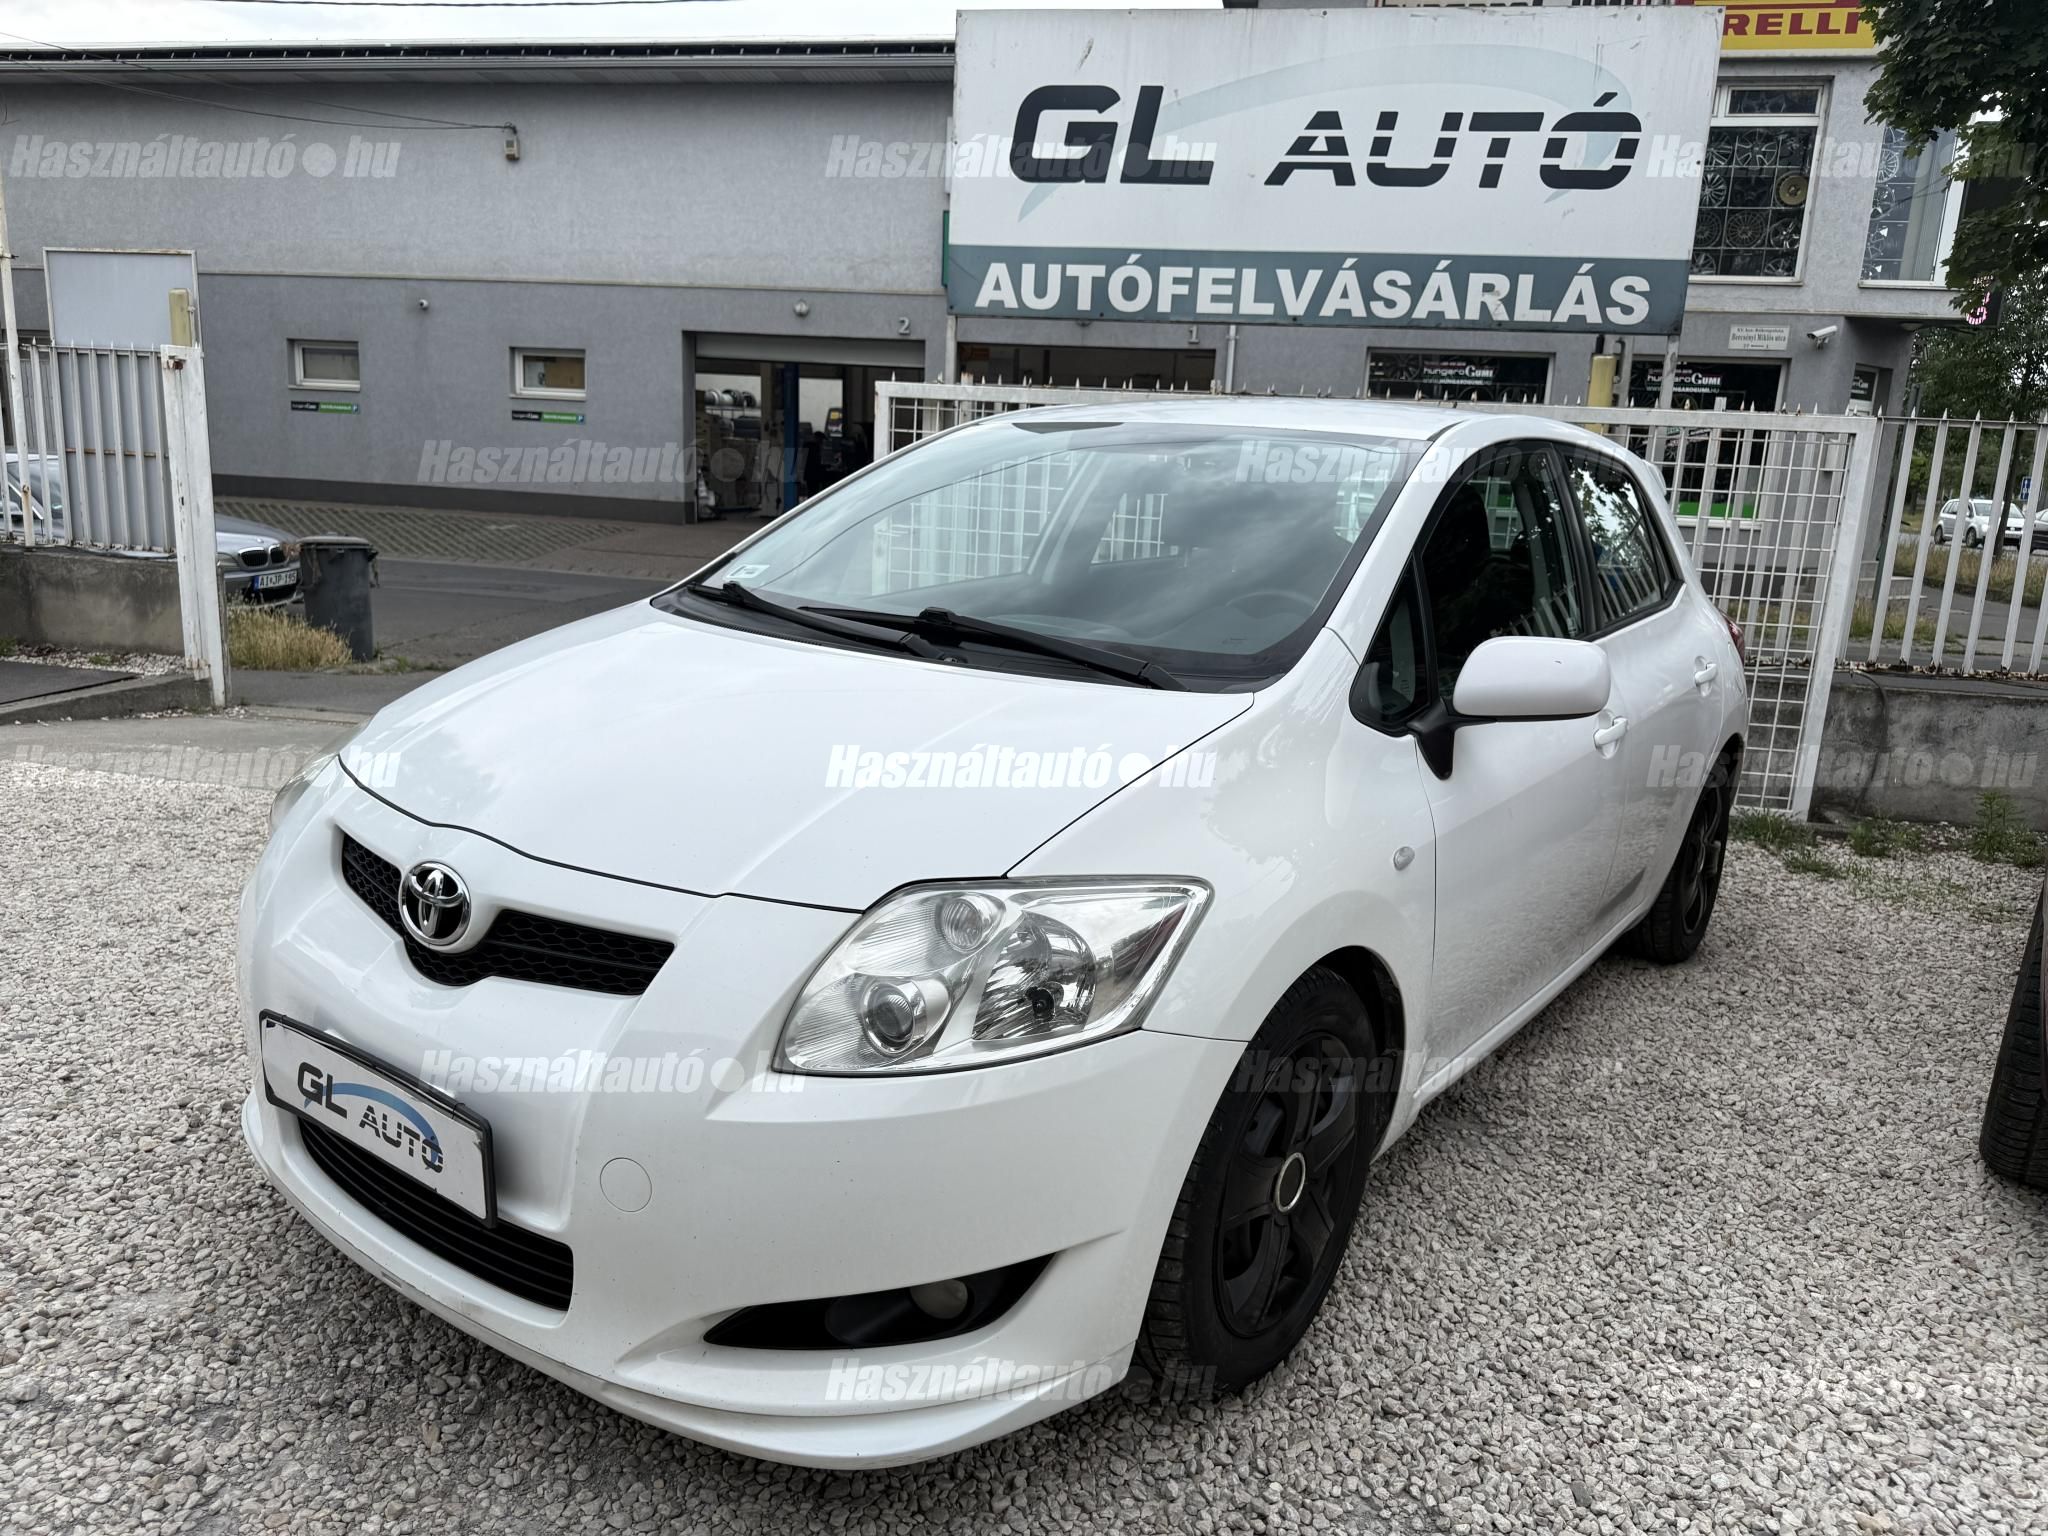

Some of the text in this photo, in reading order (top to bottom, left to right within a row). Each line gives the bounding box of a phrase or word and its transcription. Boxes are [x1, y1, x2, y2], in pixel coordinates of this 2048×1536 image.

[1722, 11, 1861, 36] RELLI
[1009, 85, 1642, 190] GL AUTÓ
[975, 253, 1650, 325] AUTÓFELVÁSÁRLÁS
[898, 316, 911, 334] 2
[1188, 325, 1200, 343] 1
[298, 1061, 347, 1119] GL
